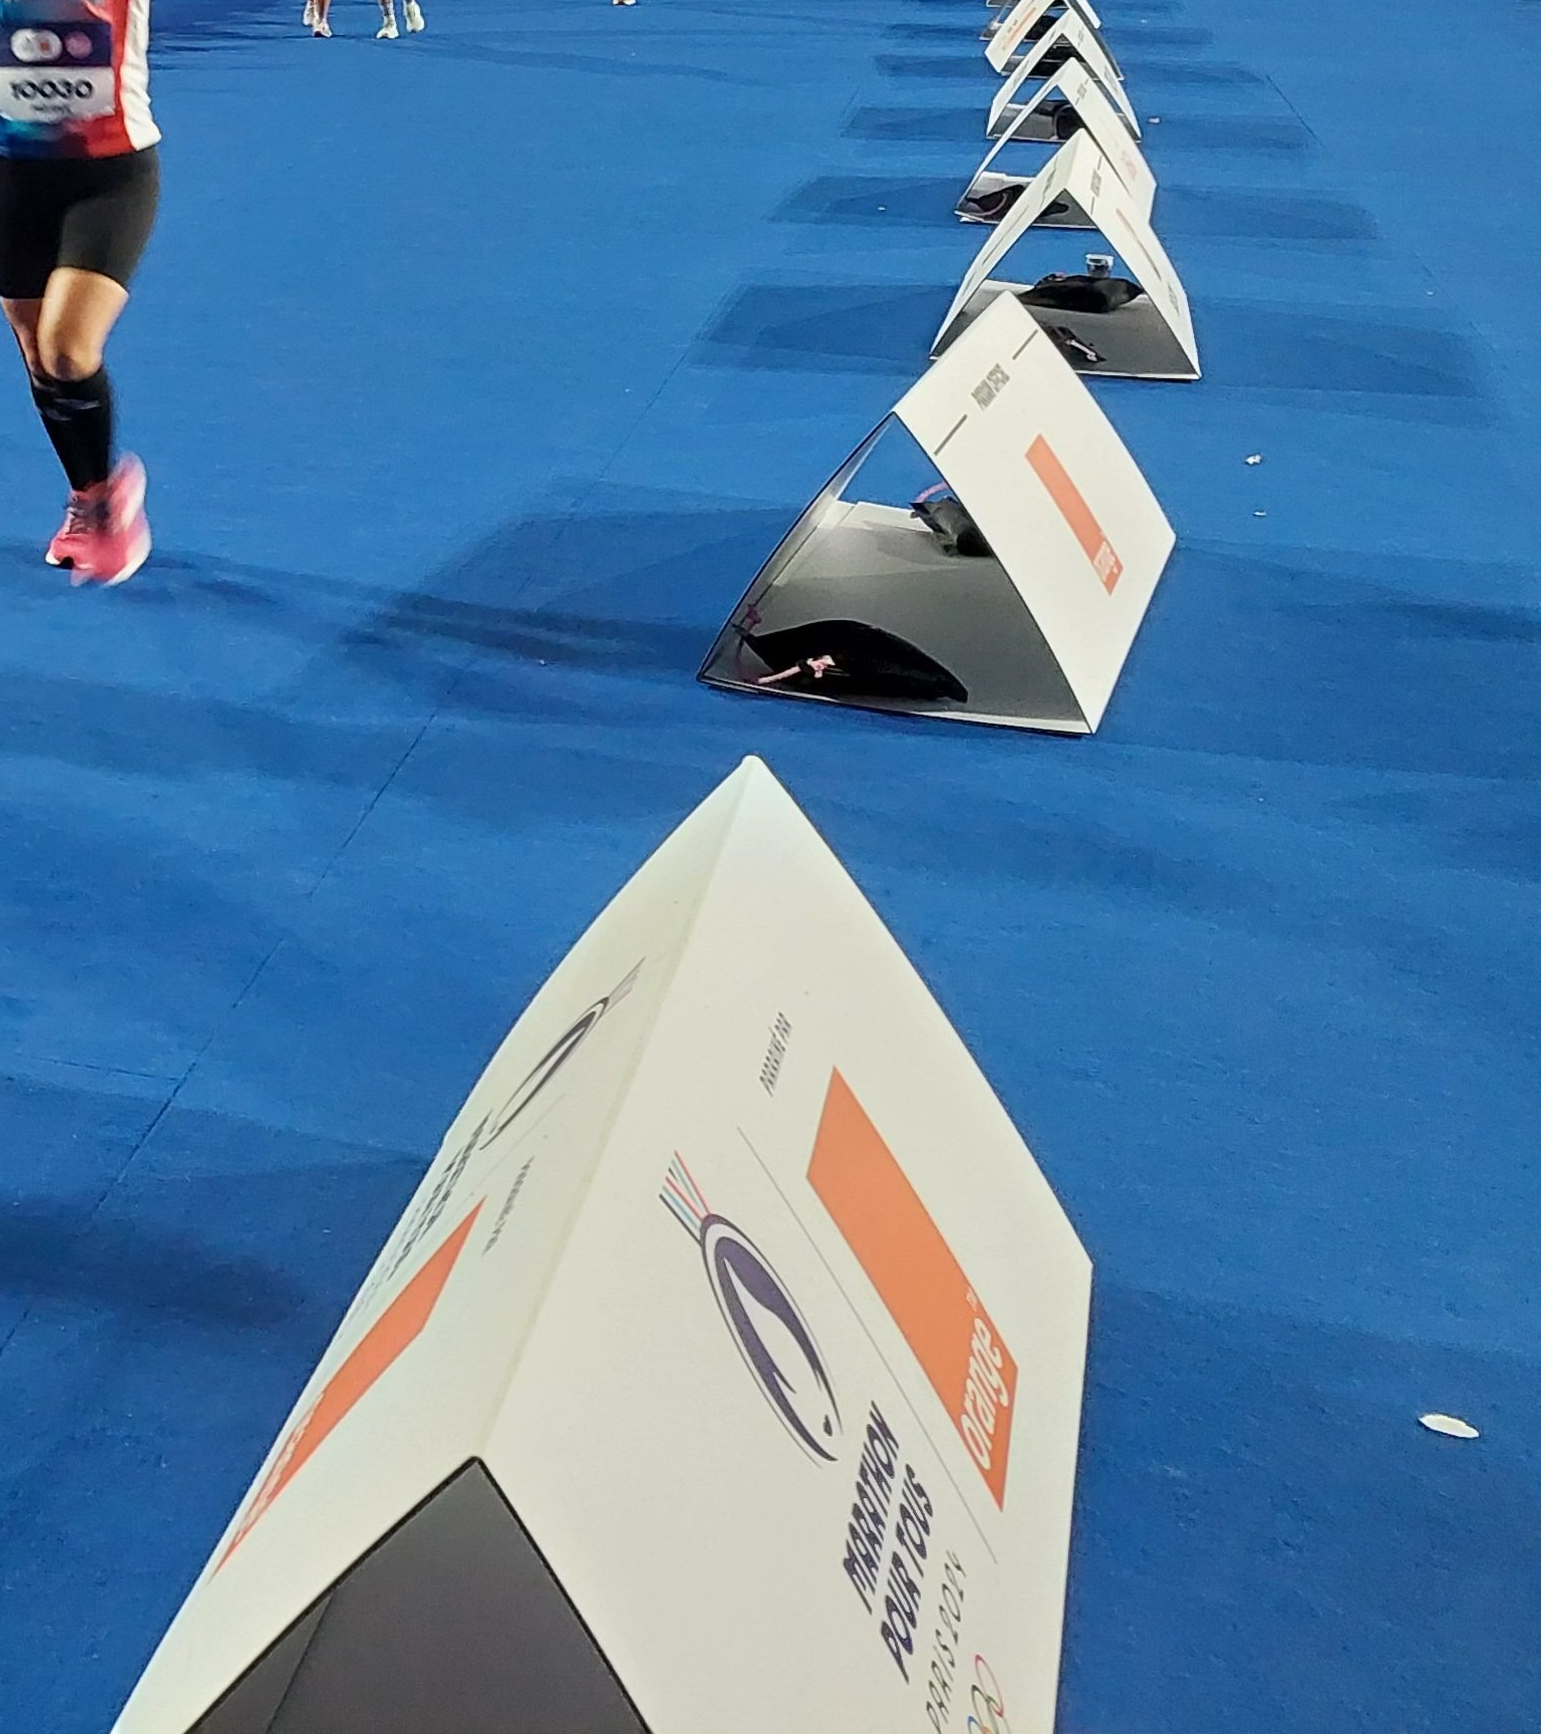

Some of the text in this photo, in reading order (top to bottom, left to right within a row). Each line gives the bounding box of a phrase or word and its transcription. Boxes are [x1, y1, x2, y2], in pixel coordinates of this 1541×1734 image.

[960, 1316, 1010, 1472] orange
[843, 1399, 900, 1616] MARATHON
[880, 1463, 934, 1686] POUR TOUS
[937, 1549, 968, 1646] 2024
